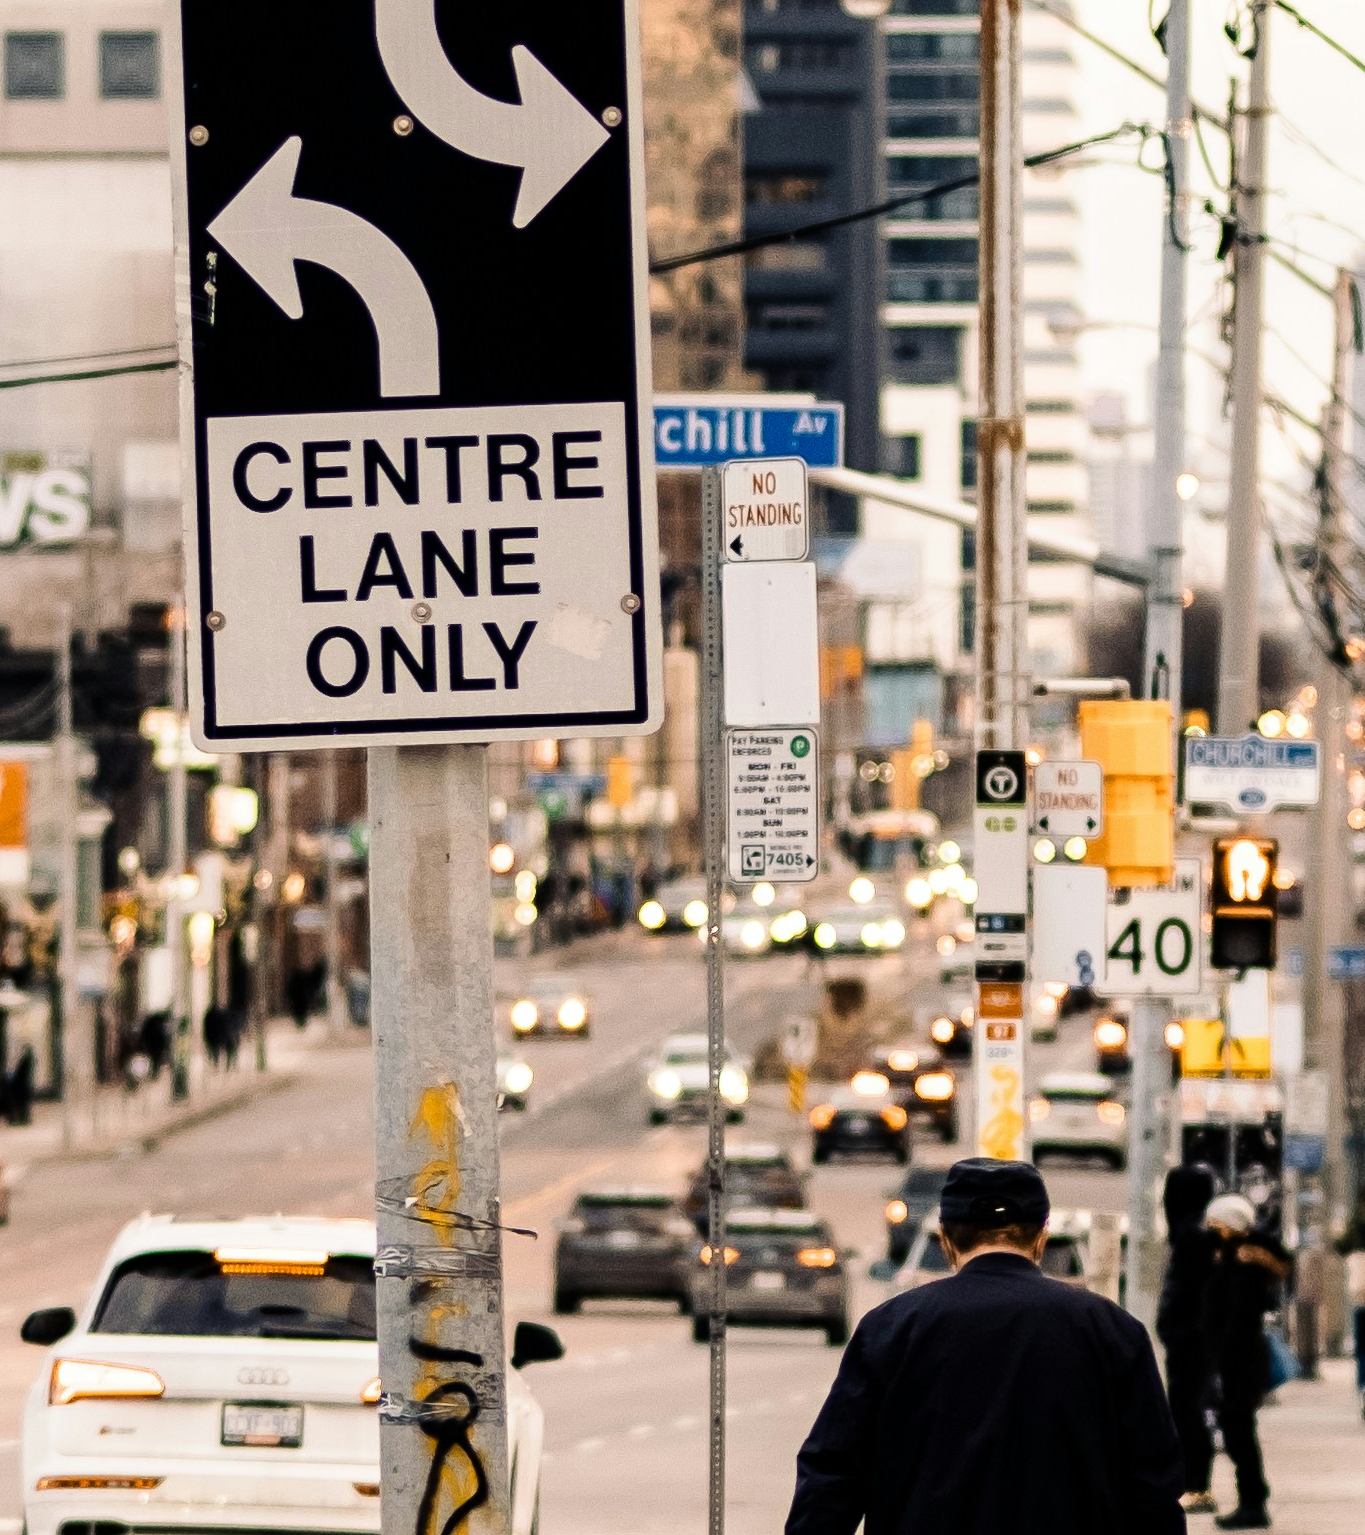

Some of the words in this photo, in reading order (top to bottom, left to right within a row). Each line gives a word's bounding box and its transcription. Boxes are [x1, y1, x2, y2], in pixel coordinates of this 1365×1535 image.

[659, 409, 765, 453] chill
[233, 430, 604, 513] CENTRE
[752, 471, 777, 495] NO
[729, 501, 802, 528] STANDING
[299, 526, 541, 603] LANE
[306, 620, 537, 698] ONLY
[1058, 768, 1079, 786] NO
[1039, 792, 1098, 810] STANDING
[767, 853, 803, 866] 7405
[1108, 916, 1193, 976] 40
